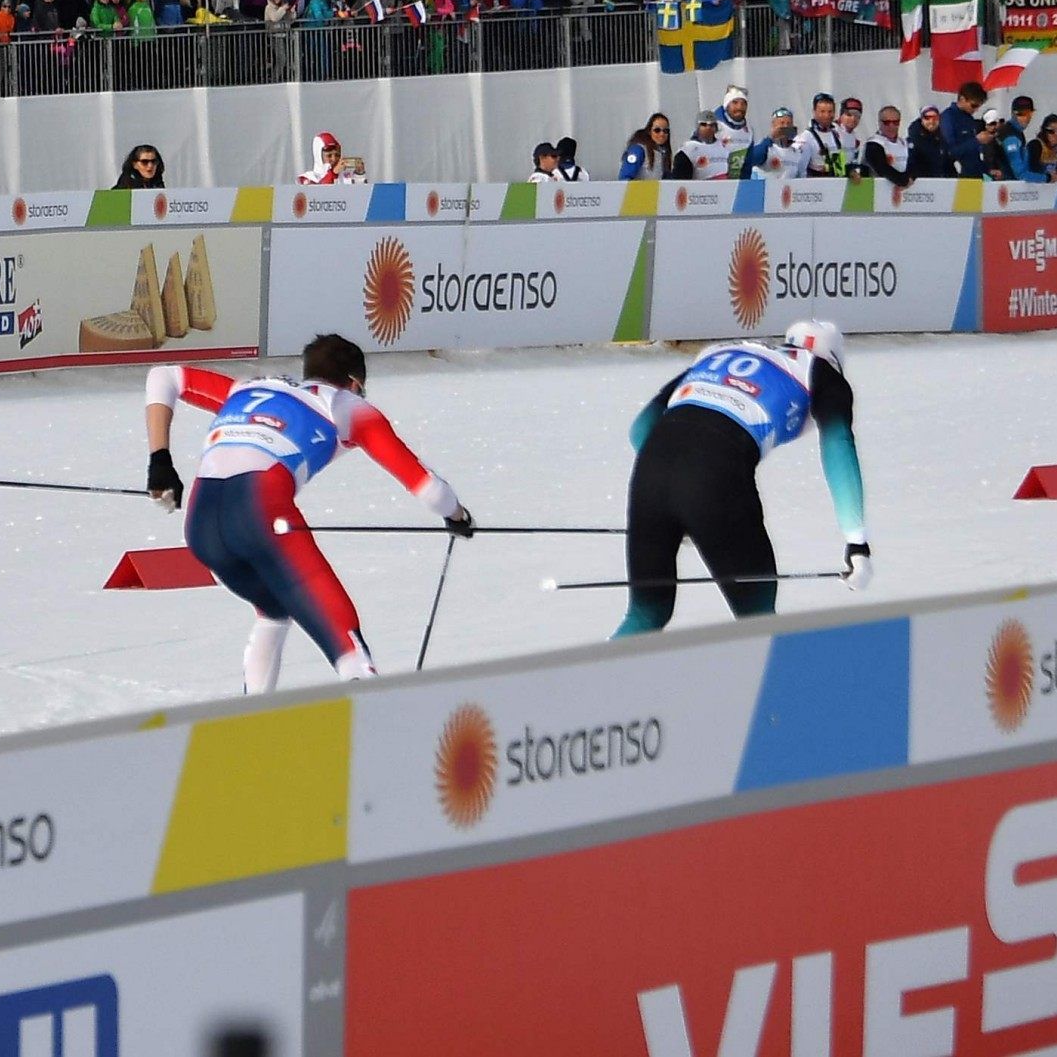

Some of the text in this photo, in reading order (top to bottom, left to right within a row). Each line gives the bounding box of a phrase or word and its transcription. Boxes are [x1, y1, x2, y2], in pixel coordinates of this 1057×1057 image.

[28, 203, 69, 218] storaenso
[169, 199, 209, 214] storaenso
[309, 197, 346, 212] storaenso
[564, 196, 601, 209] storaenso
[775, 251, 897, 300] storaenso
[421, 262, 558, 314] storaenso
[708, 352, 761, 377] 10
[242, 391, 275, 414] 7
[310, 428, 327, 445] 7
[505, 716, 662, 787] storaenso
